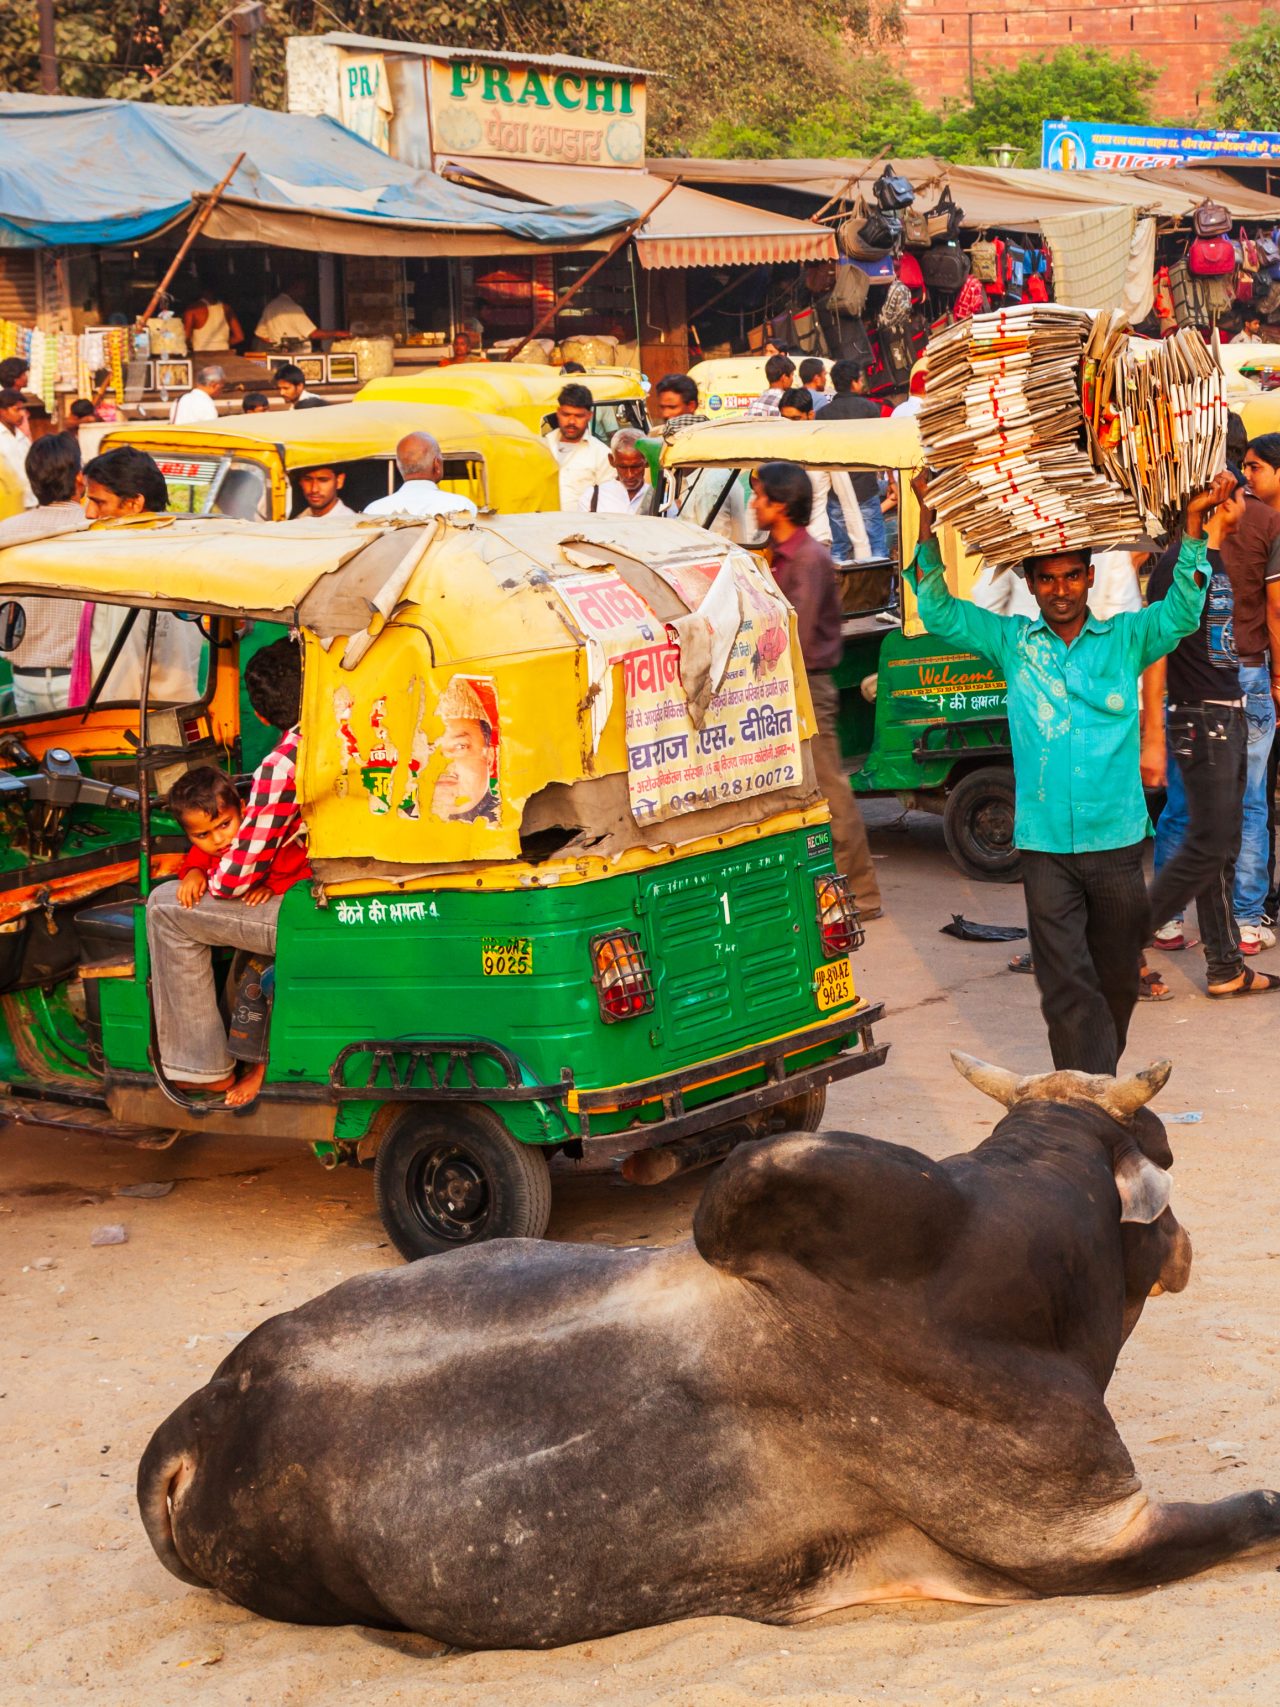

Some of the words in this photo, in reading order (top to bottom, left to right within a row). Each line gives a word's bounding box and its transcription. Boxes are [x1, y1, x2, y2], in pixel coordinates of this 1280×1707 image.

[450, 60, 636, 115] PRACHI
[918, 665, 996, 686] Welcome
[739, 704, 793, 741] दीक्षित
[670, 765, 795, 811] 09412810072
[368, 899, 389, 925] की
[484, 957, 529, 976] 9025
